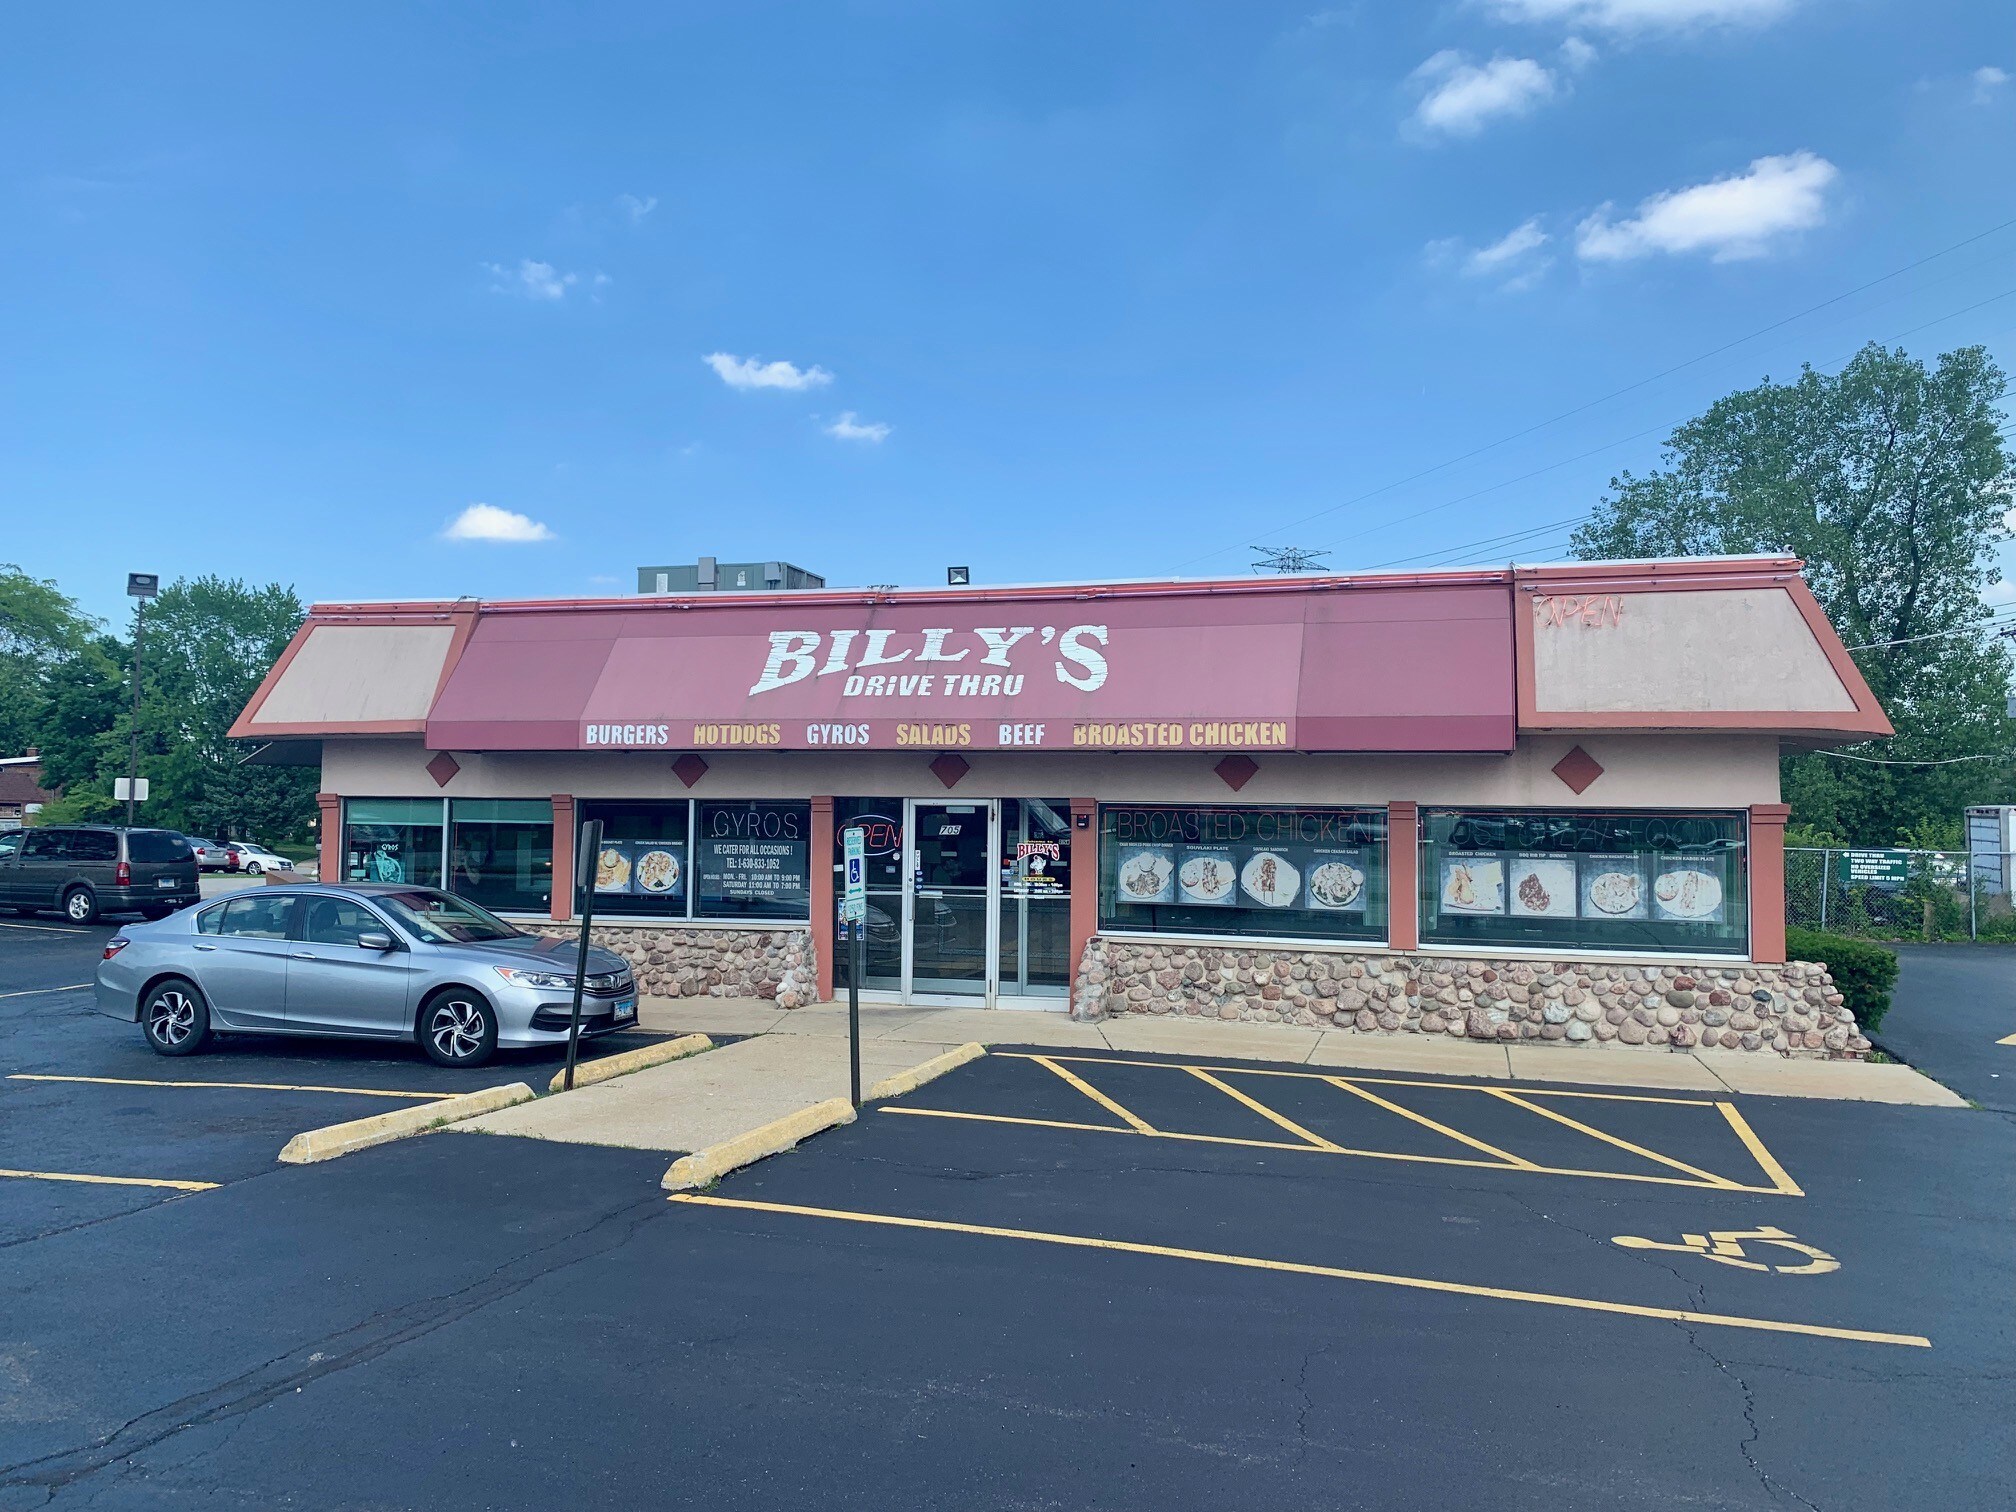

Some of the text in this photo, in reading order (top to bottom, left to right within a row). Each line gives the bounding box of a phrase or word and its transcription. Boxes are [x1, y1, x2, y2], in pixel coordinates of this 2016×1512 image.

[1536, 595, 1624, 626] OPEN
[749, 624, 1109, 696] BILLY'S
[843, 674, 1025, 696] DRIVE THRU
[586, 722, 1287, 746] BURGERS HOTDOGS GYROS SALADS BEEF BROASTED CHICKEN
[713, 810, 799, 839] GYROS
[941, 825, 960, 834] 705
[1118, 811, 1371, 842] BROASTED CHICKEN
[714, 844, 722, 854] WE
[722, 844, 738, 854] CATER
[739, 845, 749, 854] FOR
[750, 845, 759, 854] ALL
[760, 846, 790, 855] OCCASIONS
[1017, 843, 1060, 861] BILLY'S
[726, 858, 737, 868] TEL:
